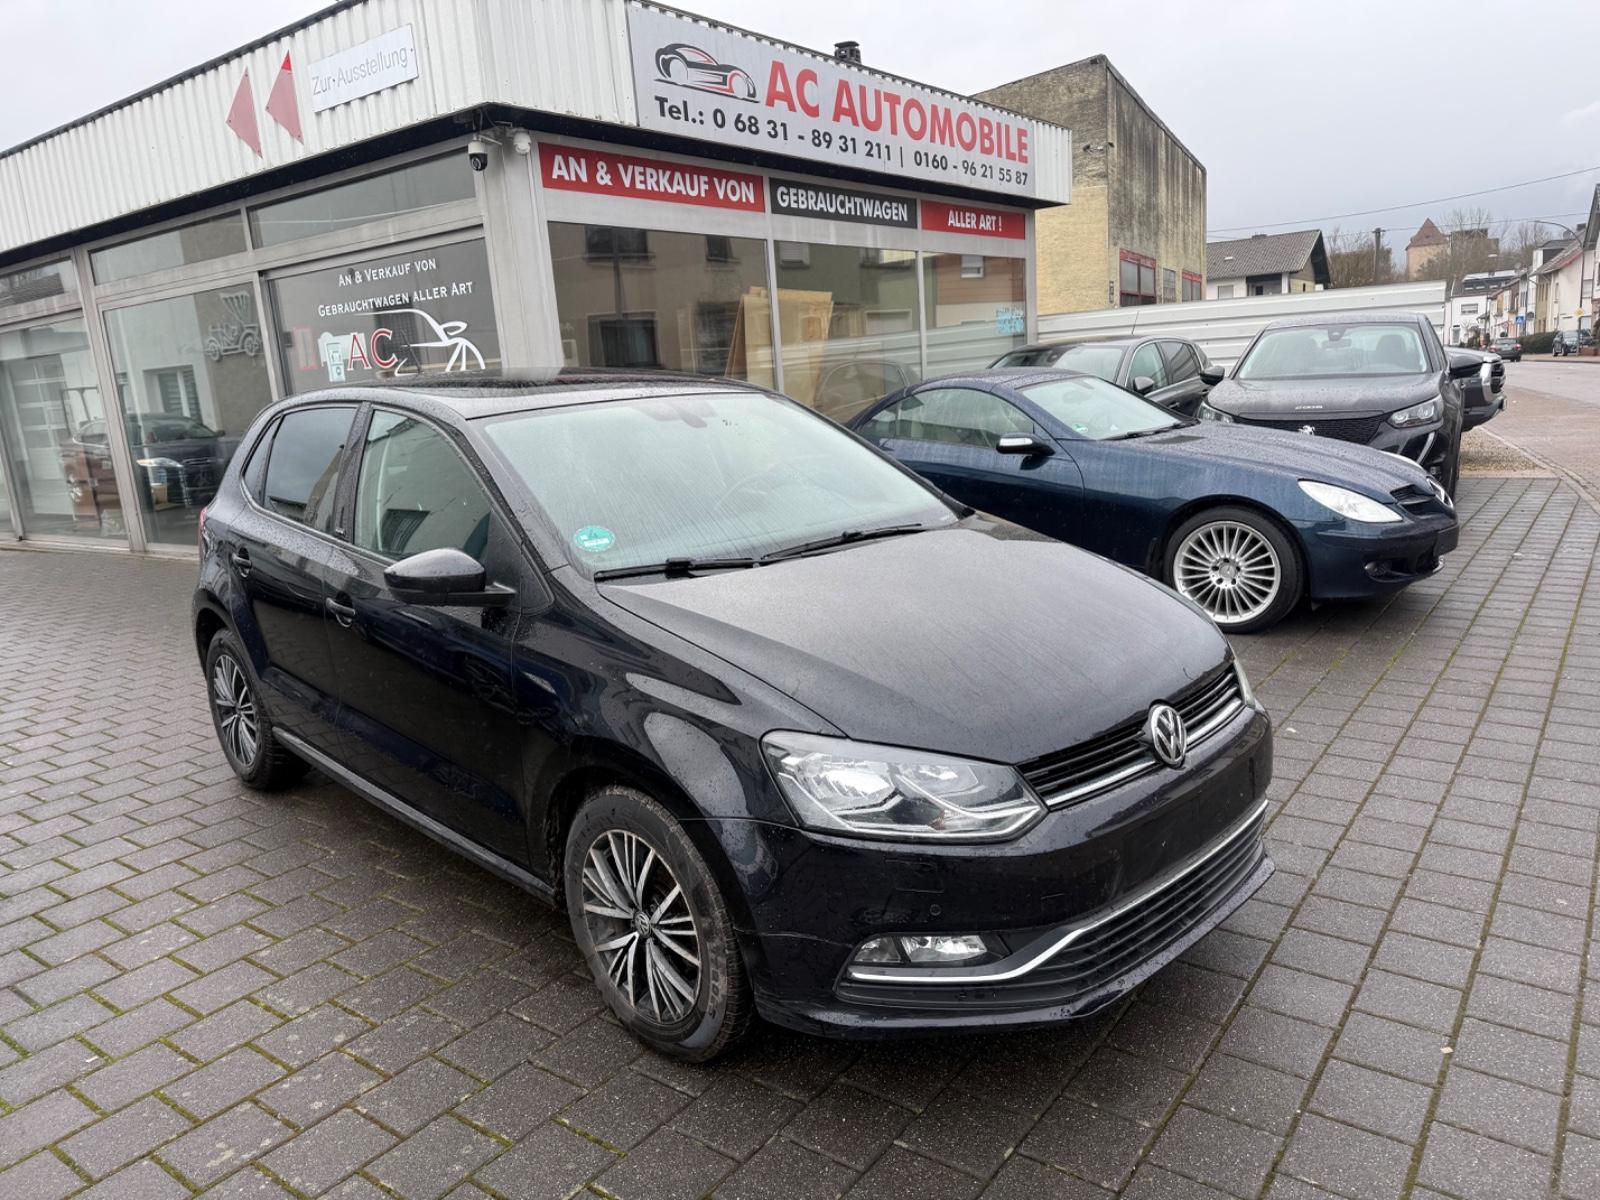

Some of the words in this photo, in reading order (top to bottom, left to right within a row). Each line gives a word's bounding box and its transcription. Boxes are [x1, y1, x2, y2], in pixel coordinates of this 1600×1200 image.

[312, 75, 331, 95] Zur
[337, 47, 408, 87] Ausstellung
[765, 60, 820, 118] AC
[832, 79, 1028, 164] AUTOMOBILE
[654, 95, 704, 125] Tel.:
[713, 108, 726, 129] 0
[734, 113, 759, 135] 68
[767, 119, 788, 141] 31
[812, 129, 832, 149] 89
[839, 135, 857, 154] 31
[864, 140, 891, 161] 211
[914, 151, 948, 171] 0160
[962, 160, 977, 176] 96
[981, 164, 993, 179] 21
[999, 168, 1012, 182] 55
[1015, 171, 1028, 186] 87
[552, 155, 588, 183] AN
[596, 160, 613, 186] &
[617, 163, 709, 198] VERKAUF
[713, 177, 755, 204] VON
[776, 186, 908, 222] GEBRAUCHTWAGEN
[948, 210, 976, 229] ALLER
[979, 214, 998, 231] ART
[355, 271, 363, 284] &
[347, 328, 398, 371] AC
